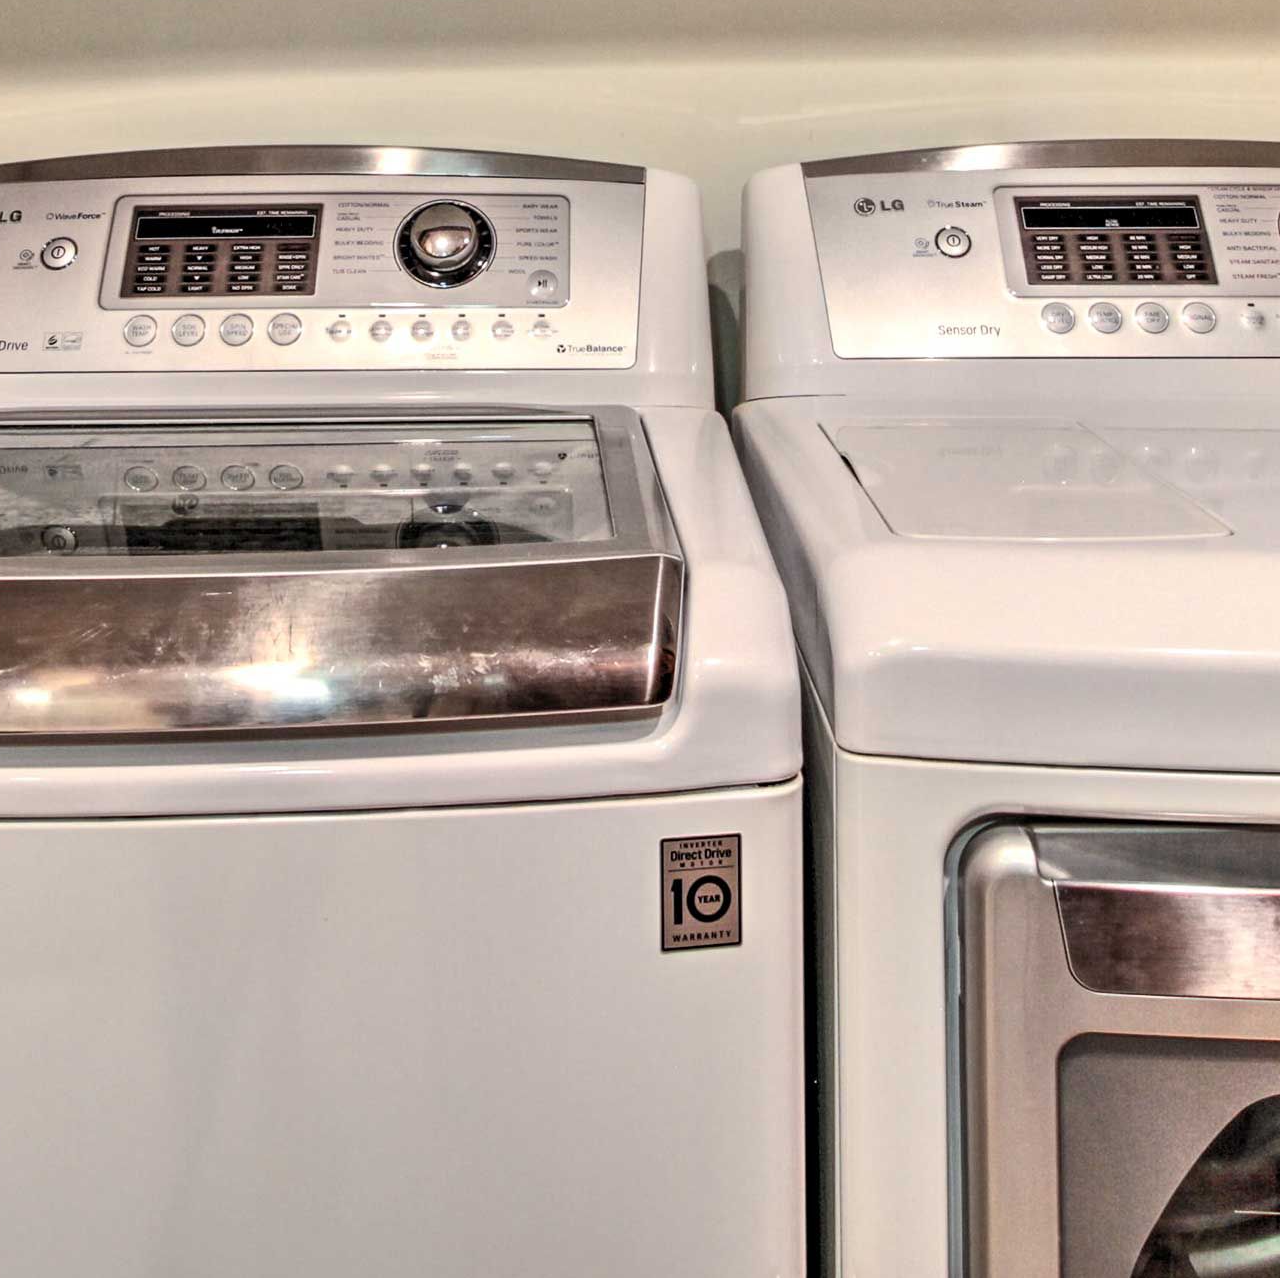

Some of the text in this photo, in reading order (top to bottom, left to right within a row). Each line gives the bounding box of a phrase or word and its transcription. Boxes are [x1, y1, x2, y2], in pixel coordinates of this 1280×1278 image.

[880, 199, 905, 212] LG
[938, 324, 1001, 338] Sensor Dry
[680, 840, 724, 850] INVERTER
[670, 848, 732, 862] Direct Drive
[670, 874, 732, 925] 10
[698, 894, 721, 904] YEAR
[672, 930, 732, 942] WARRANTY
